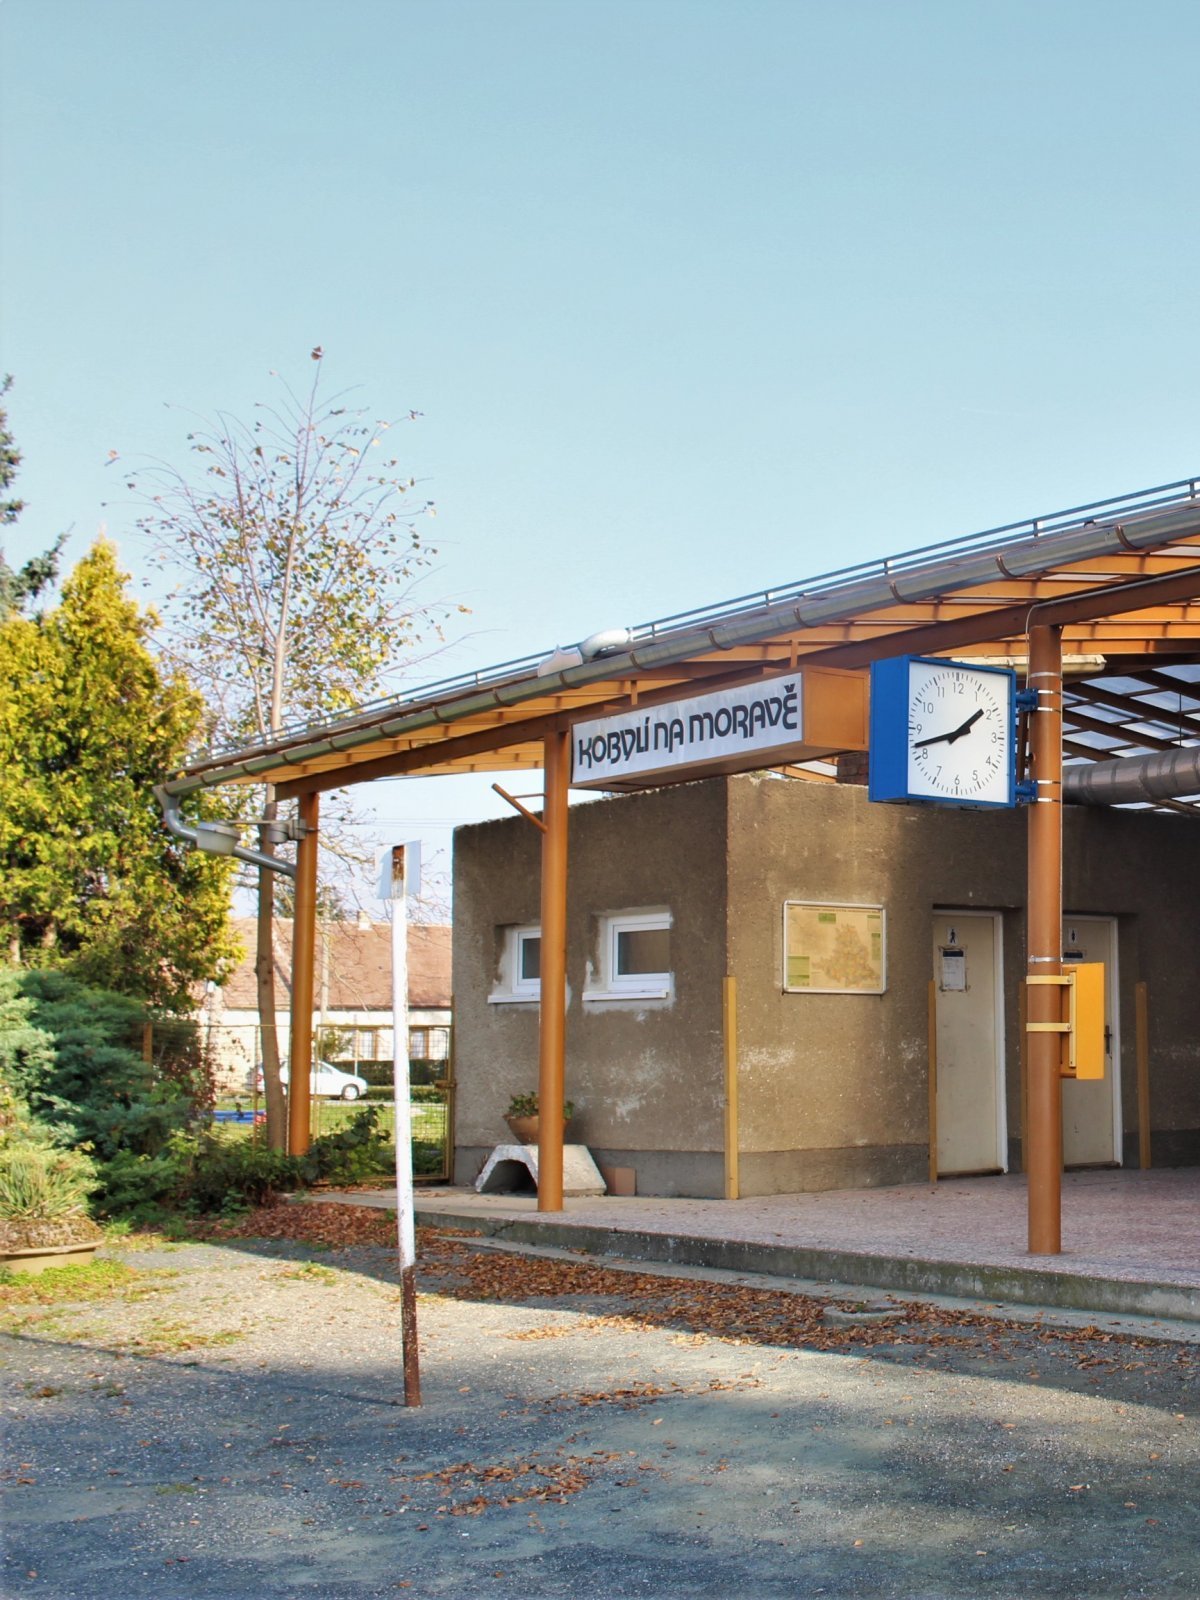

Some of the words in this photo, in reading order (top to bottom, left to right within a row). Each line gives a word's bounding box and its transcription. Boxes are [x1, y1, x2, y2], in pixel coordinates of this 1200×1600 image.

[937, 687, 945, 698] 11
[952, 682, 964, 694] 12
[922, 702, 934, 714] 10
[985, 709, 992, 720] 2
[578, 716, 650, 769] KOBYLÍ
[654, 718, 684, 753] NA
[689, 683, 798, 739] MORAVĚ
[916, 724, 923, 735] 9
[991, 732, 997, 743] 3
[921, 748, 928, 760] 8
[985, 756, 991, 766] 4
[936, 766, 942, 777] 7
[972, 770, 978, 781] 5
[954, 775, 960, 785] 6
